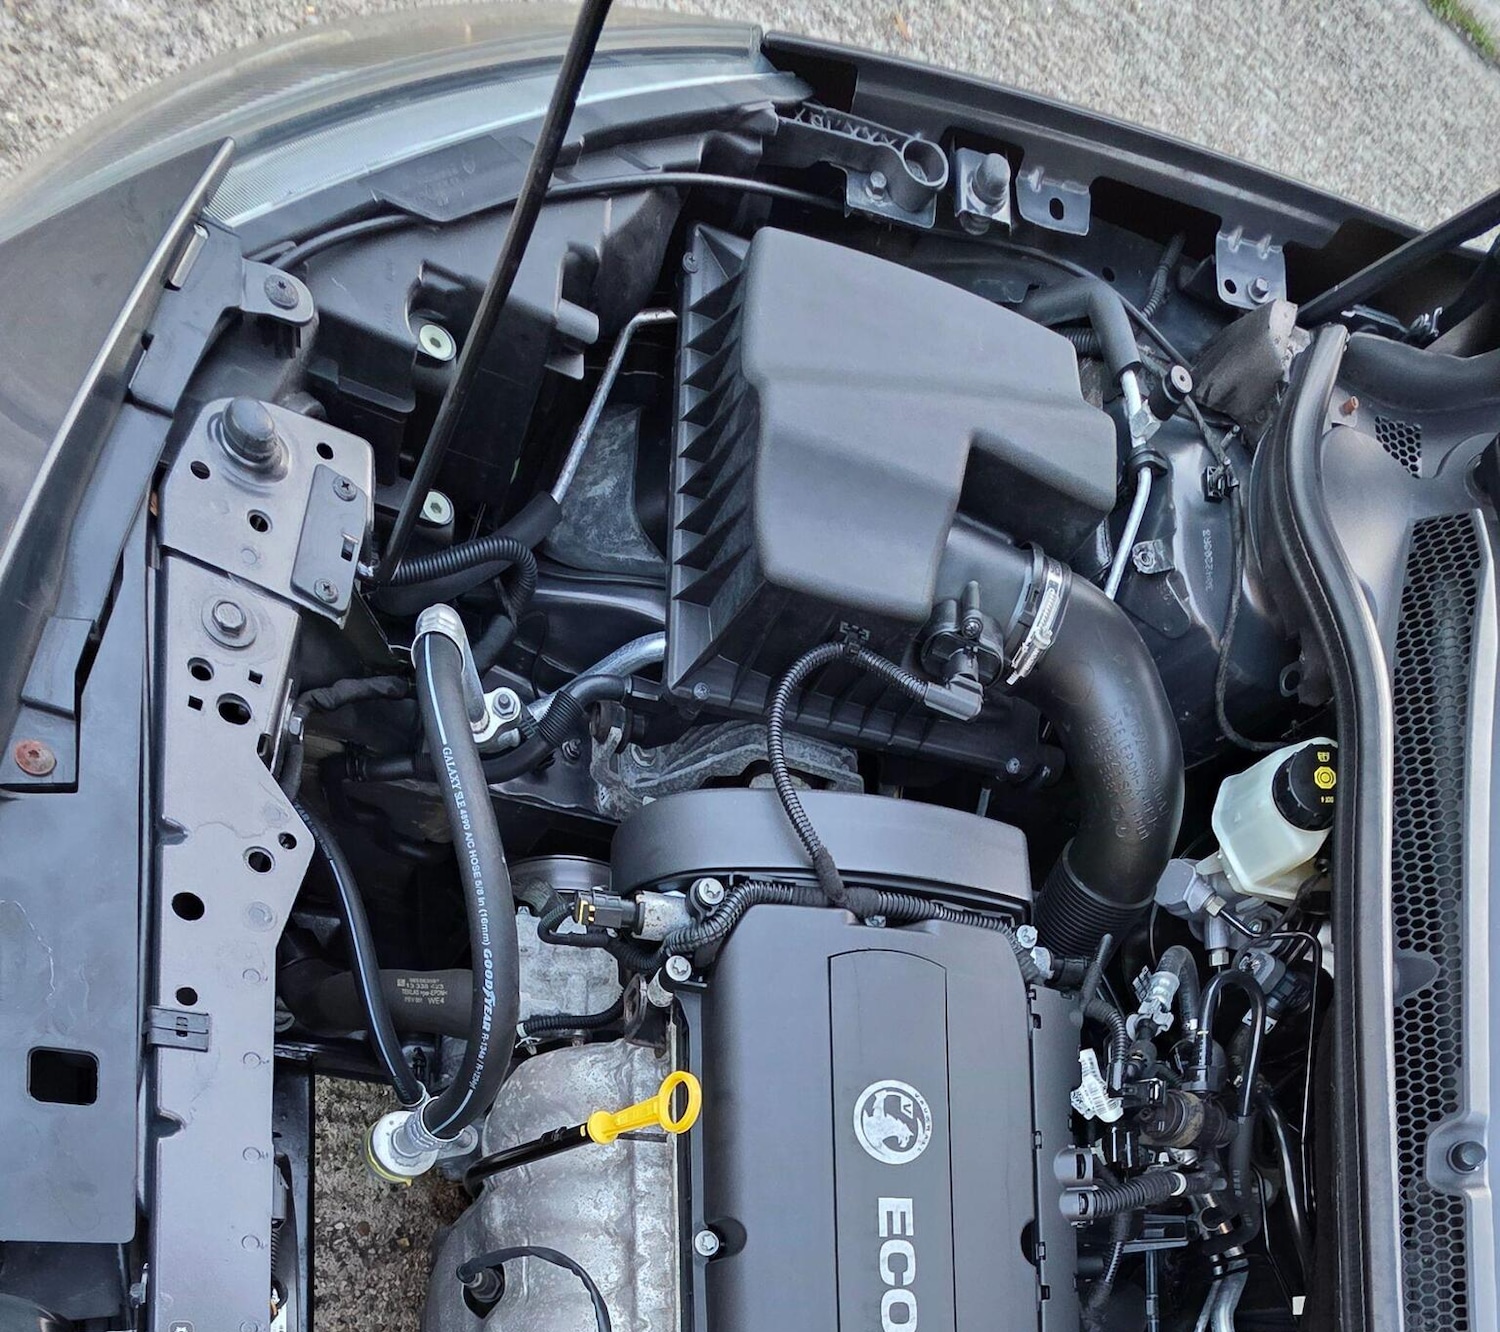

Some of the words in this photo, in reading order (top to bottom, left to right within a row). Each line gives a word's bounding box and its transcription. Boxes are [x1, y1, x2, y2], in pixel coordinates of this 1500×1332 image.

[442, 747, 462, 790] GALAXY
[469, 849, 482, 879] HOSE
[478, 908, 491, 946] (16mm)
[482, 948, 496, 1032] GOODYEAR
